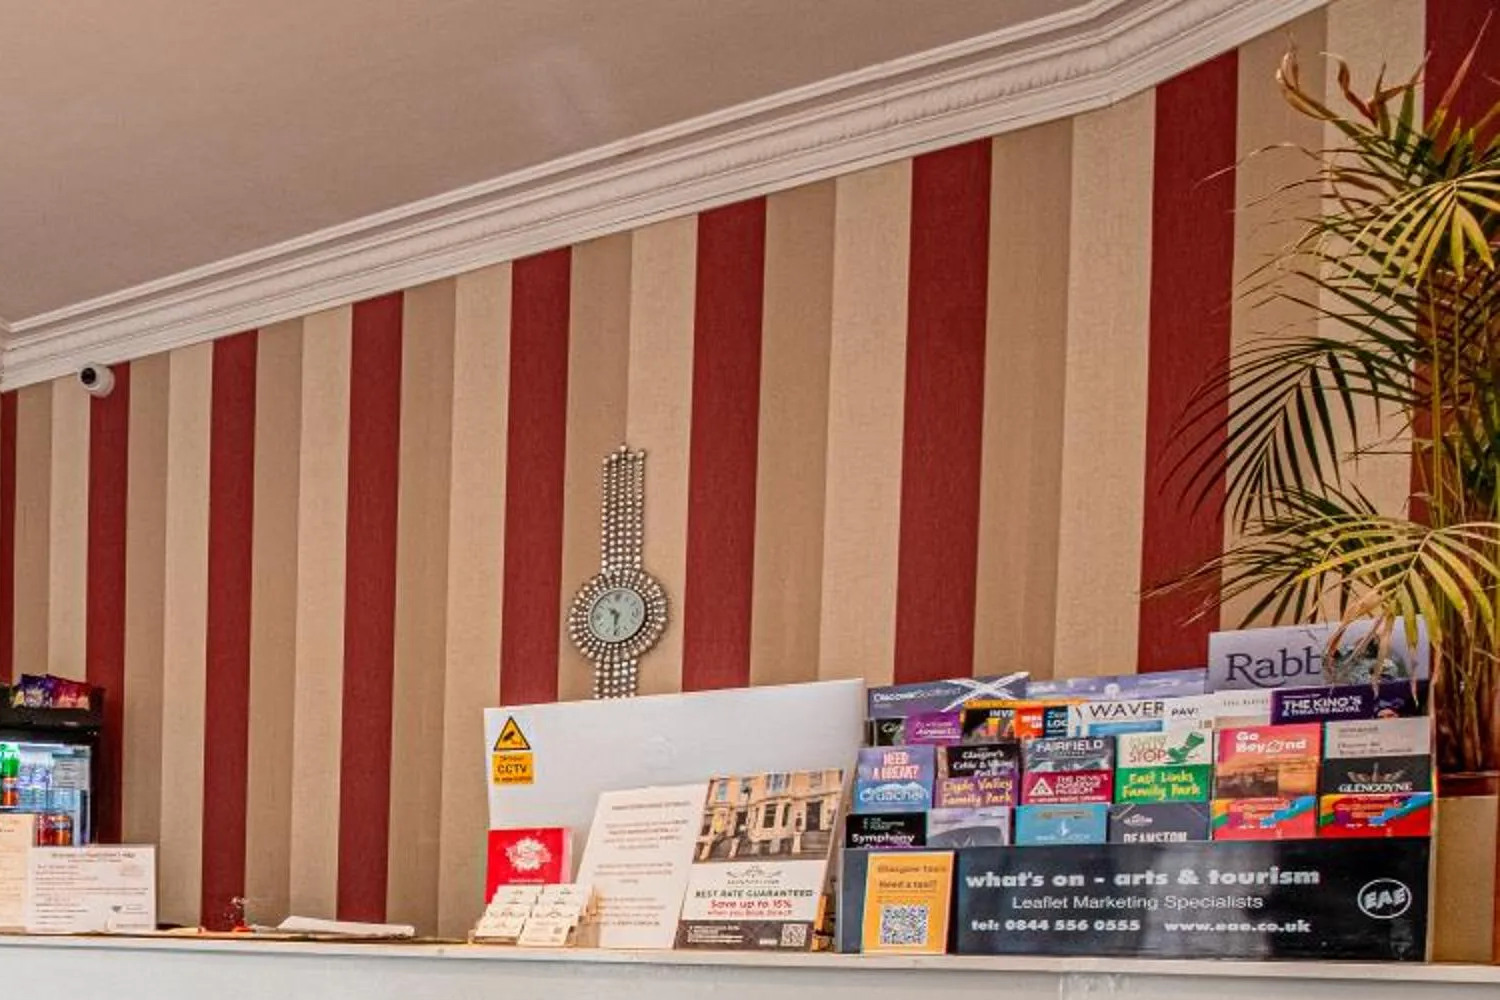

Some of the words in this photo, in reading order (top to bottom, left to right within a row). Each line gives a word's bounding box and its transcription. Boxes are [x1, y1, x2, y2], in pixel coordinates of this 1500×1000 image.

[1283, 700, 1311, 711] THE
[1313, 695, 1363, 709] KING'S
[1236, 731, 1260, 742] Go
[1035, 739, 1104, 753] FAIRFIELD
[497, 763, 528, 775] CCTV
[977, 777, 1013, 792] Valley
[1128, 772, 1156, 784] East
[1161, 771, 1194, 783] Links
[1123, 785, 1166, 801] Family
[1171, 783, 1200, 797] Park
[1338, 782, 1413, 793] GLENGOYNE
[942, 794, 981, 807] Family
[851, 832, 915, 846] Symphony
[966, 871, 1045, 887] what's
[1052, 875, 1085, 887] on
[1114, 870, 1169, 886] arts
[1177, 869, 1200, 885] &
[1208, 866, 1321, 885] tourism
[695, 889, 717, 898] BEST
[720, 889, 744, 898] RATE
[746, 889, 814, 898] GUARANTEED
[1363, 886, 1407, 909] EAE
[711, 900, 737, 909] Save
[739, 901, 755, 911] up
[757, 900, 769, 909] to
[773, 899, 793, 909] 15%
[1011, 896, 1068, 909] Leaflet
[1073, 896, 1158, 912] Marketing
[1163, 895, 1264, 912] Specialists
[971, 919, 999, 931] tel:
[1005, 919, 1050, 931] 0844
[1055, 919, 1089, 931] 556
[1094, 919, 1141, 931] 0555
[1164, 919, 1312, 933] www.eae.co.uk
